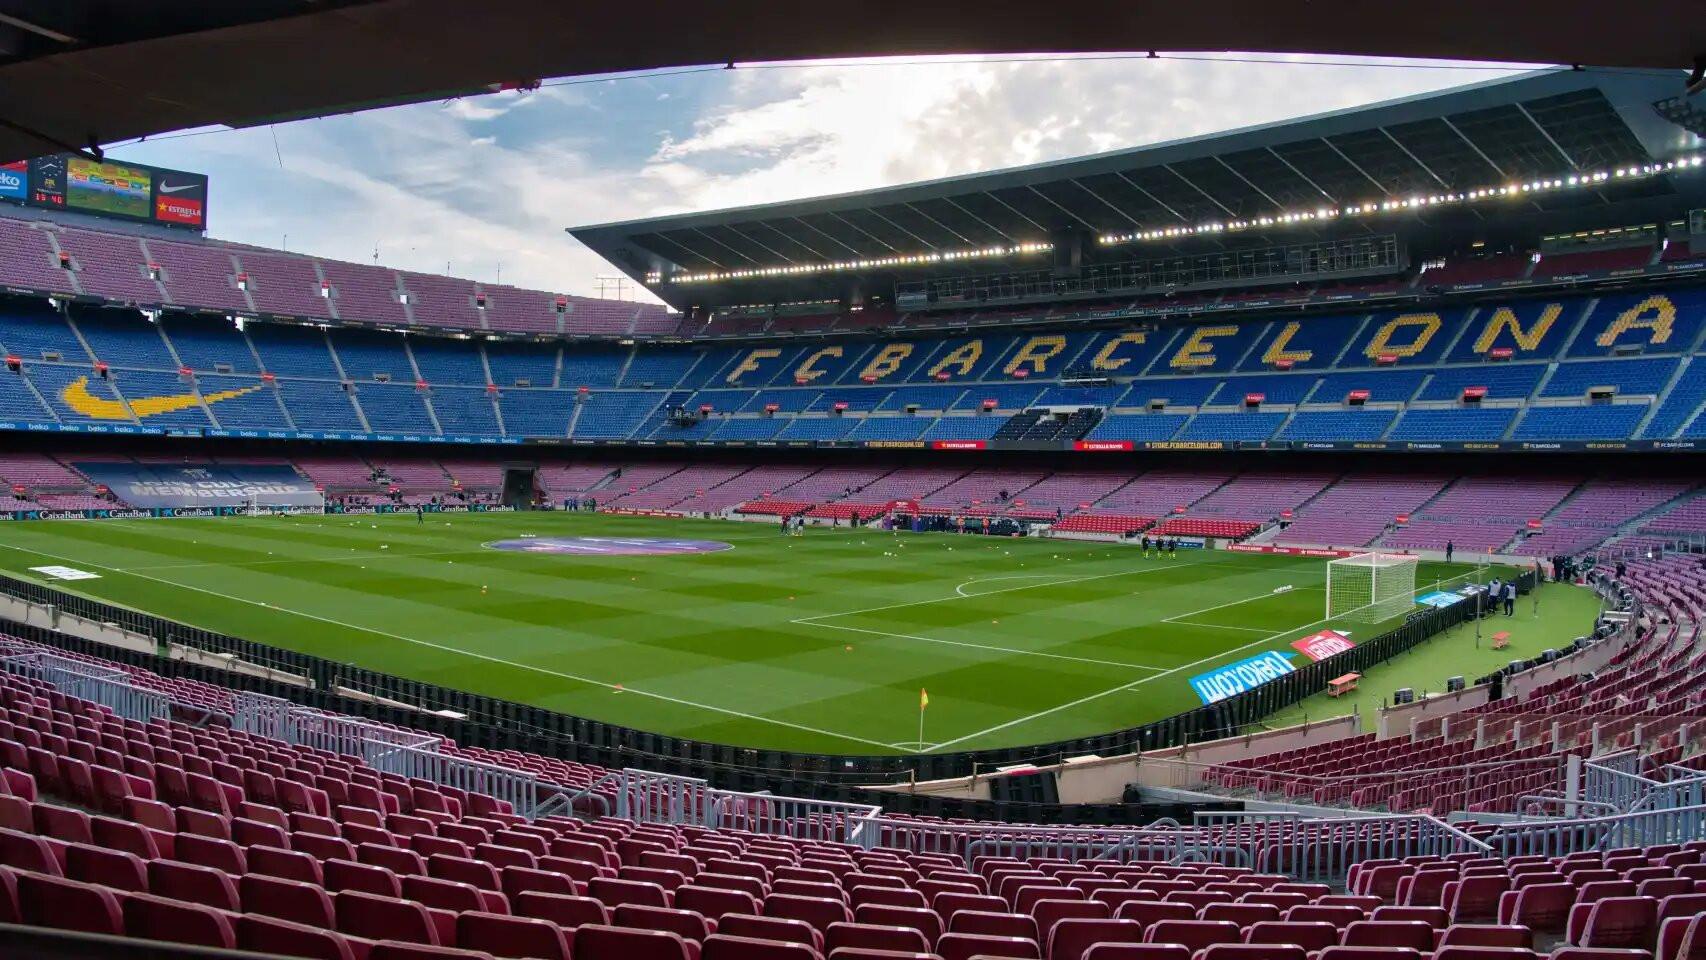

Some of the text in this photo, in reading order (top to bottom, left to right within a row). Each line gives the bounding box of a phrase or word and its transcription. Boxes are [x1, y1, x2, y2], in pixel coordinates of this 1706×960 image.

[725, 295, 1677, 383] FC BARCELONA
[130, 485, 299, 497] MEMBERSHIP
[174, 508, 214, 517] CaixaBank
[343, 505, 376, 514] CaixaBank
[439, 504, 469, 513] CaixaBank
[485, 504, 515, 512] CaixaBank
[39, 511, 86, 520] CaixaBank
[109, 509, 152, 518] CaixaBank
[1196, 650, 1297, 704] beko.com
